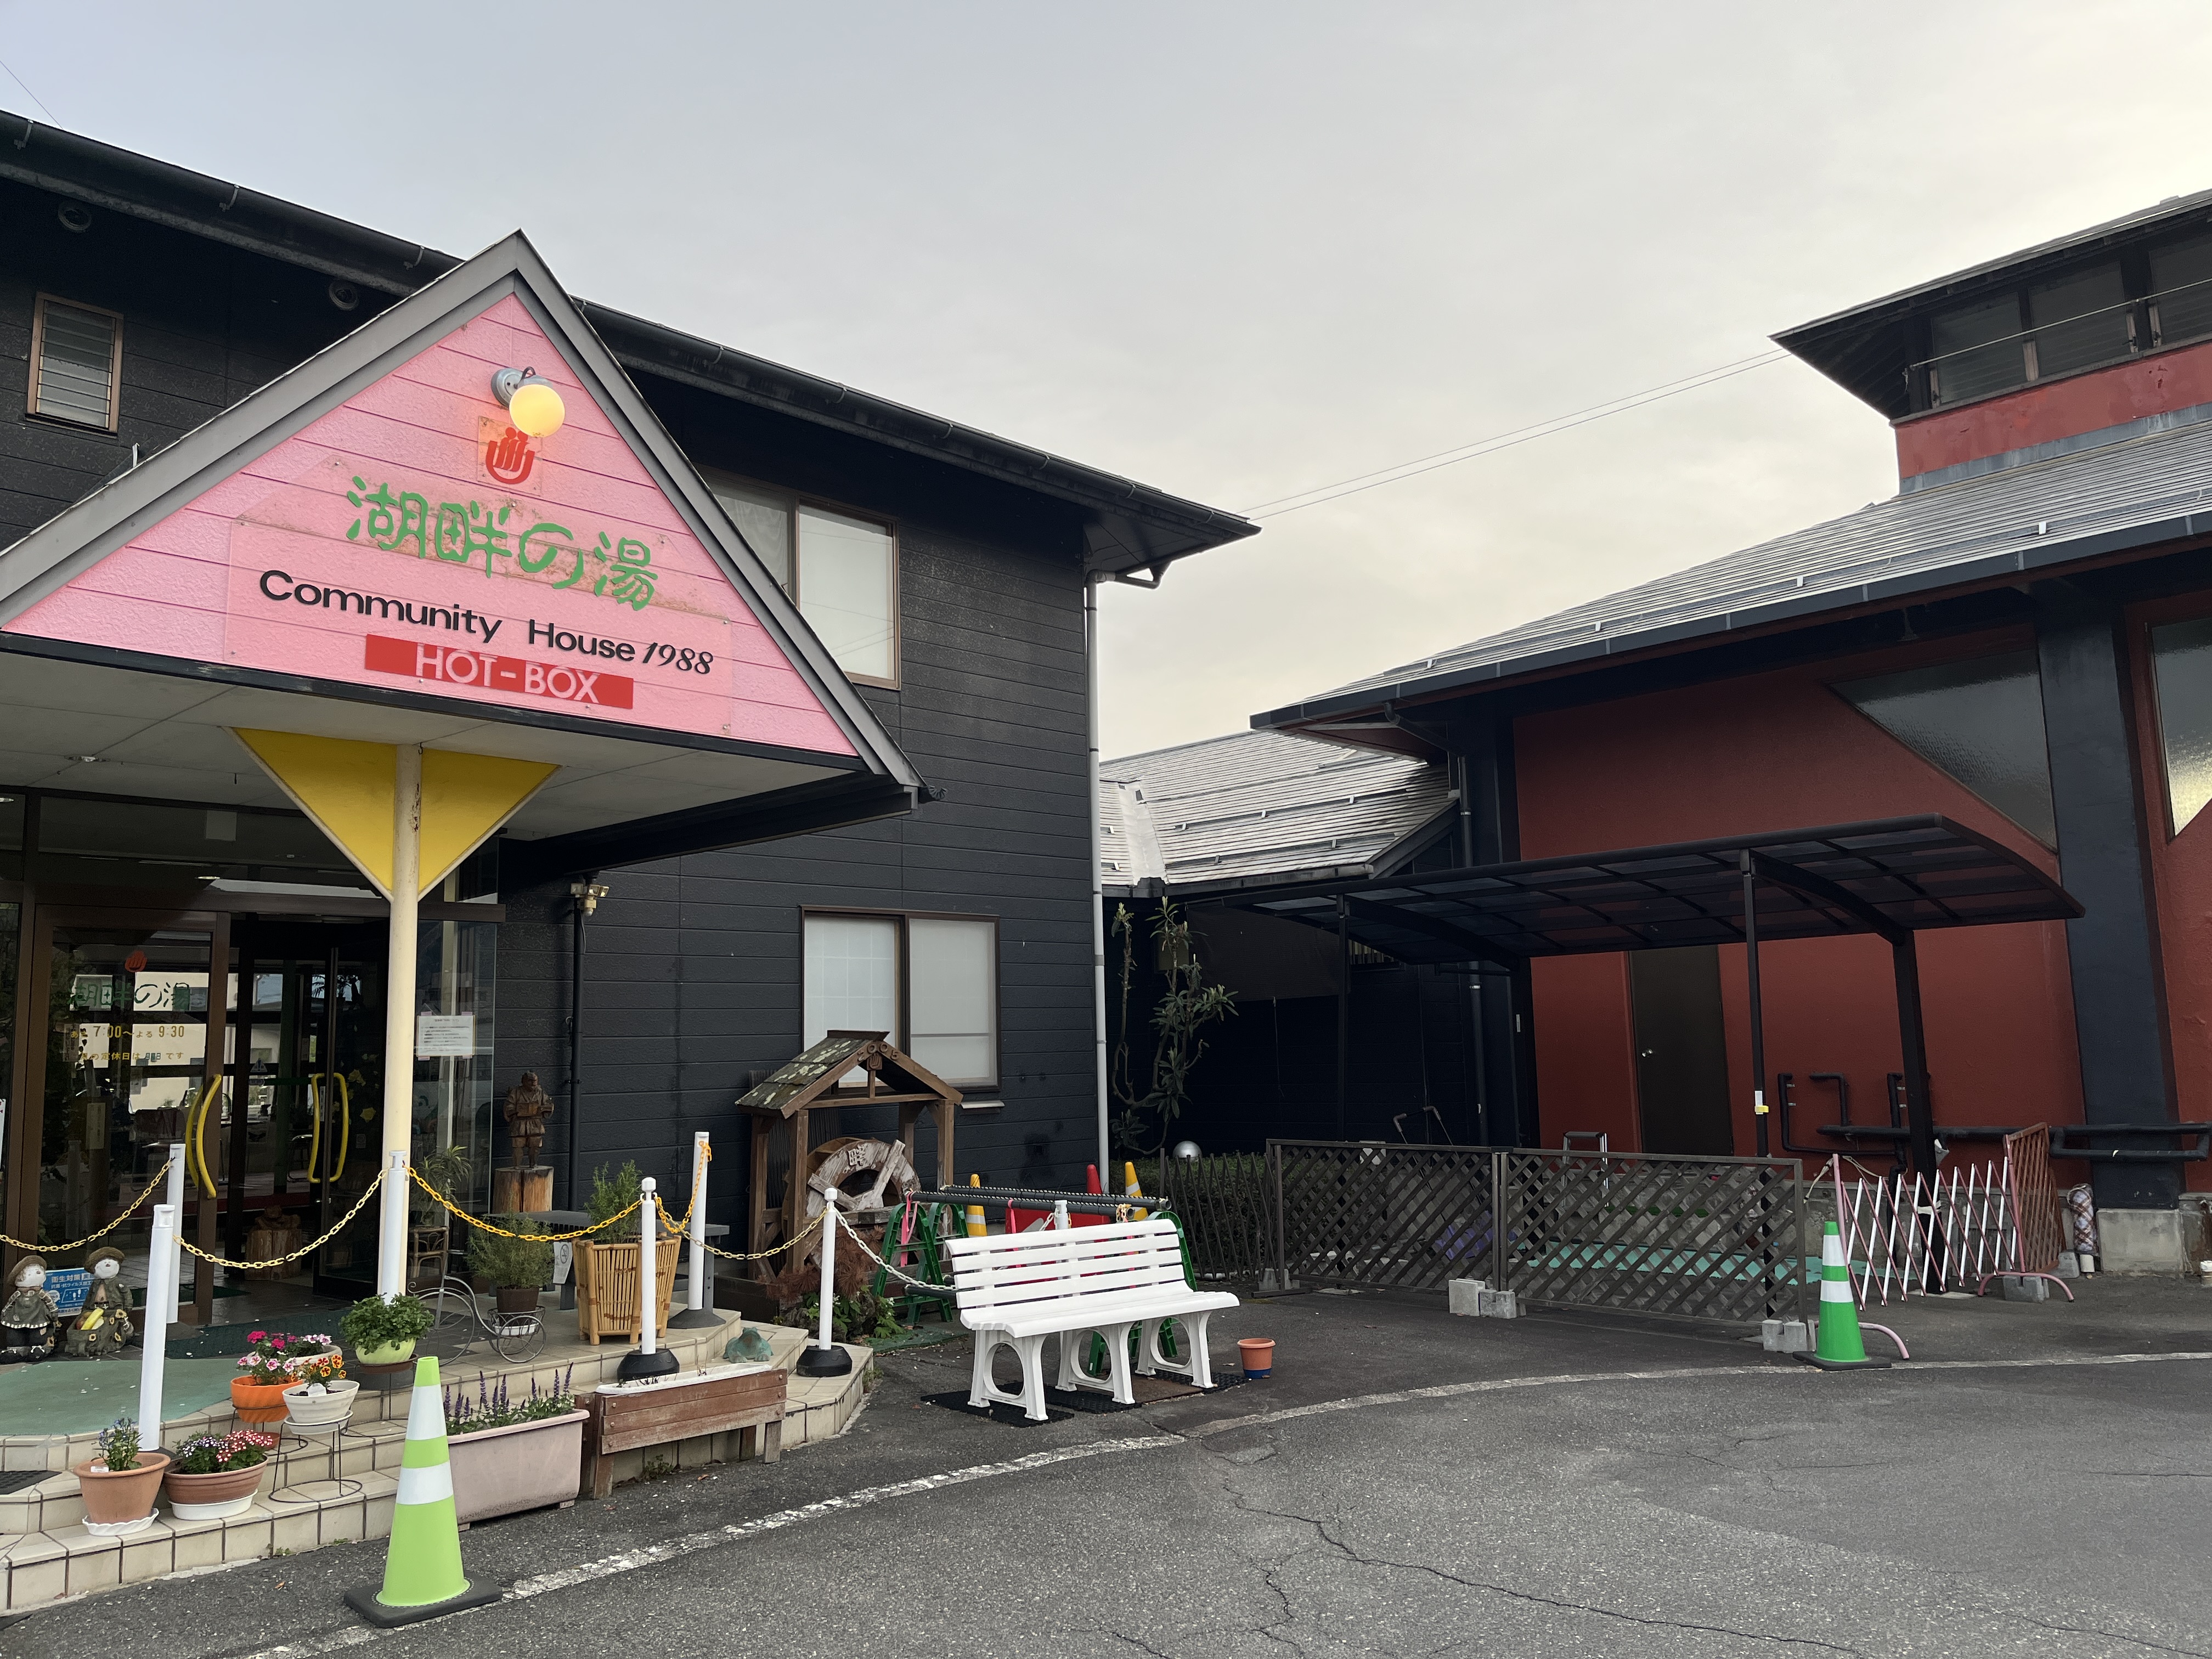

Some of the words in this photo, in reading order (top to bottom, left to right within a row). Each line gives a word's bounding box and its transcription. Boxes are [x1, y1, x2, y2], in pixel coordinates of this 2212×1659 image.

[347, 475, 658, 610] 湖畔の湯
[260, 570, 503, 644] Community
[529, 619, 636, 662] House
[642, 642, 714, 675] 1988
[415, 642, 601, 704] HOT-BOX
[159, 1025, 185, 1038] 9:30
